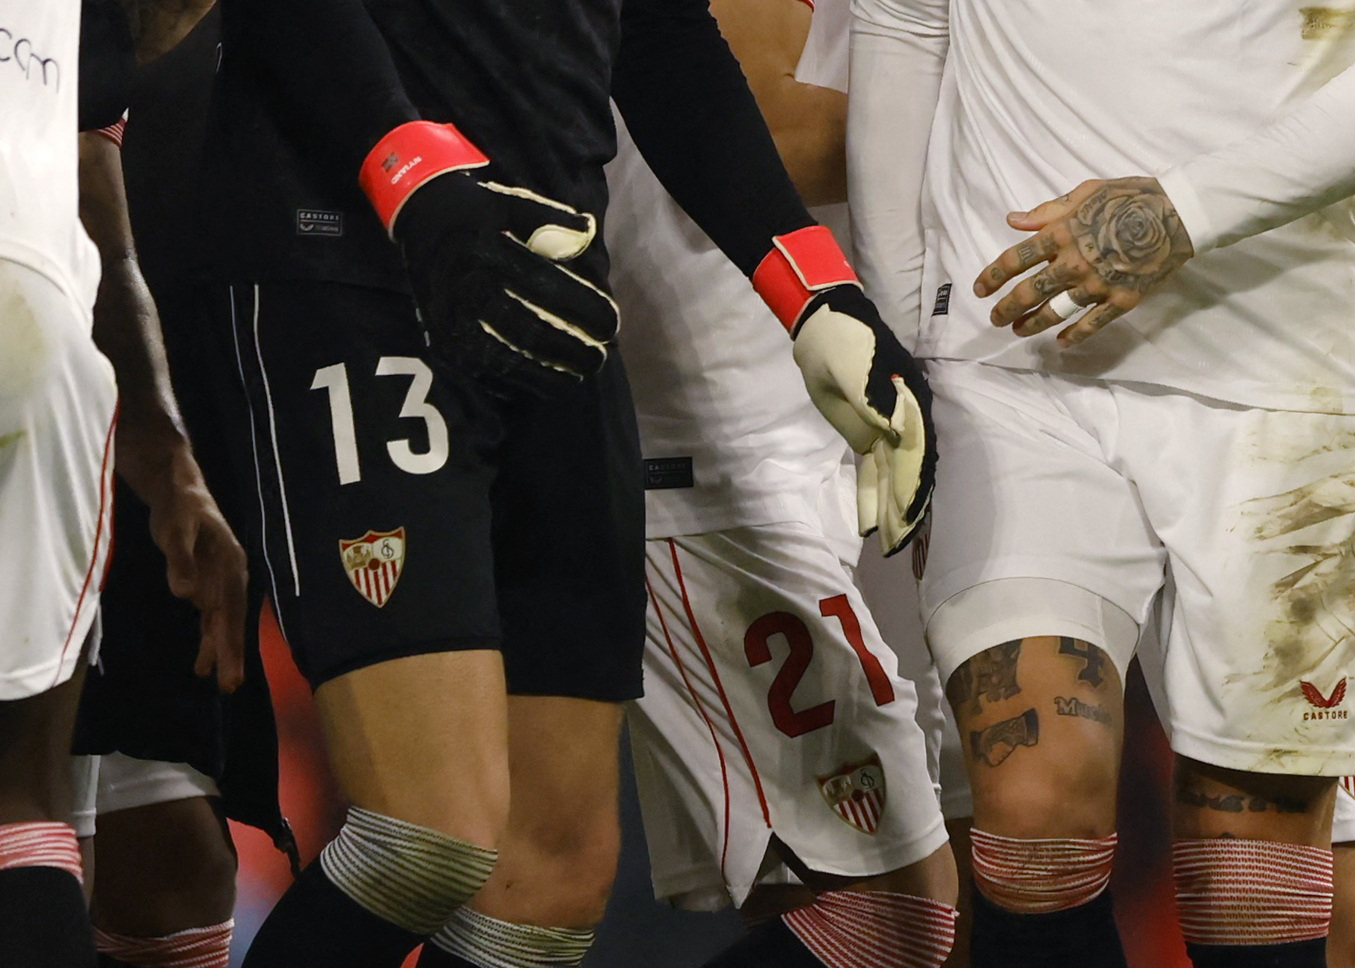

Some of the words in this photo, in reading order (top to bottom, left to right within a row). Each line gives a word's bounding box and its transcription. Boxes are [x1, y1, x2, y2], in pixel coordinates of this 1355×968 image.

[309, 355, 450, 486] 13
[743, 593, 896, 739] 21
[1302, 709, 1349, 722] CASTORE
